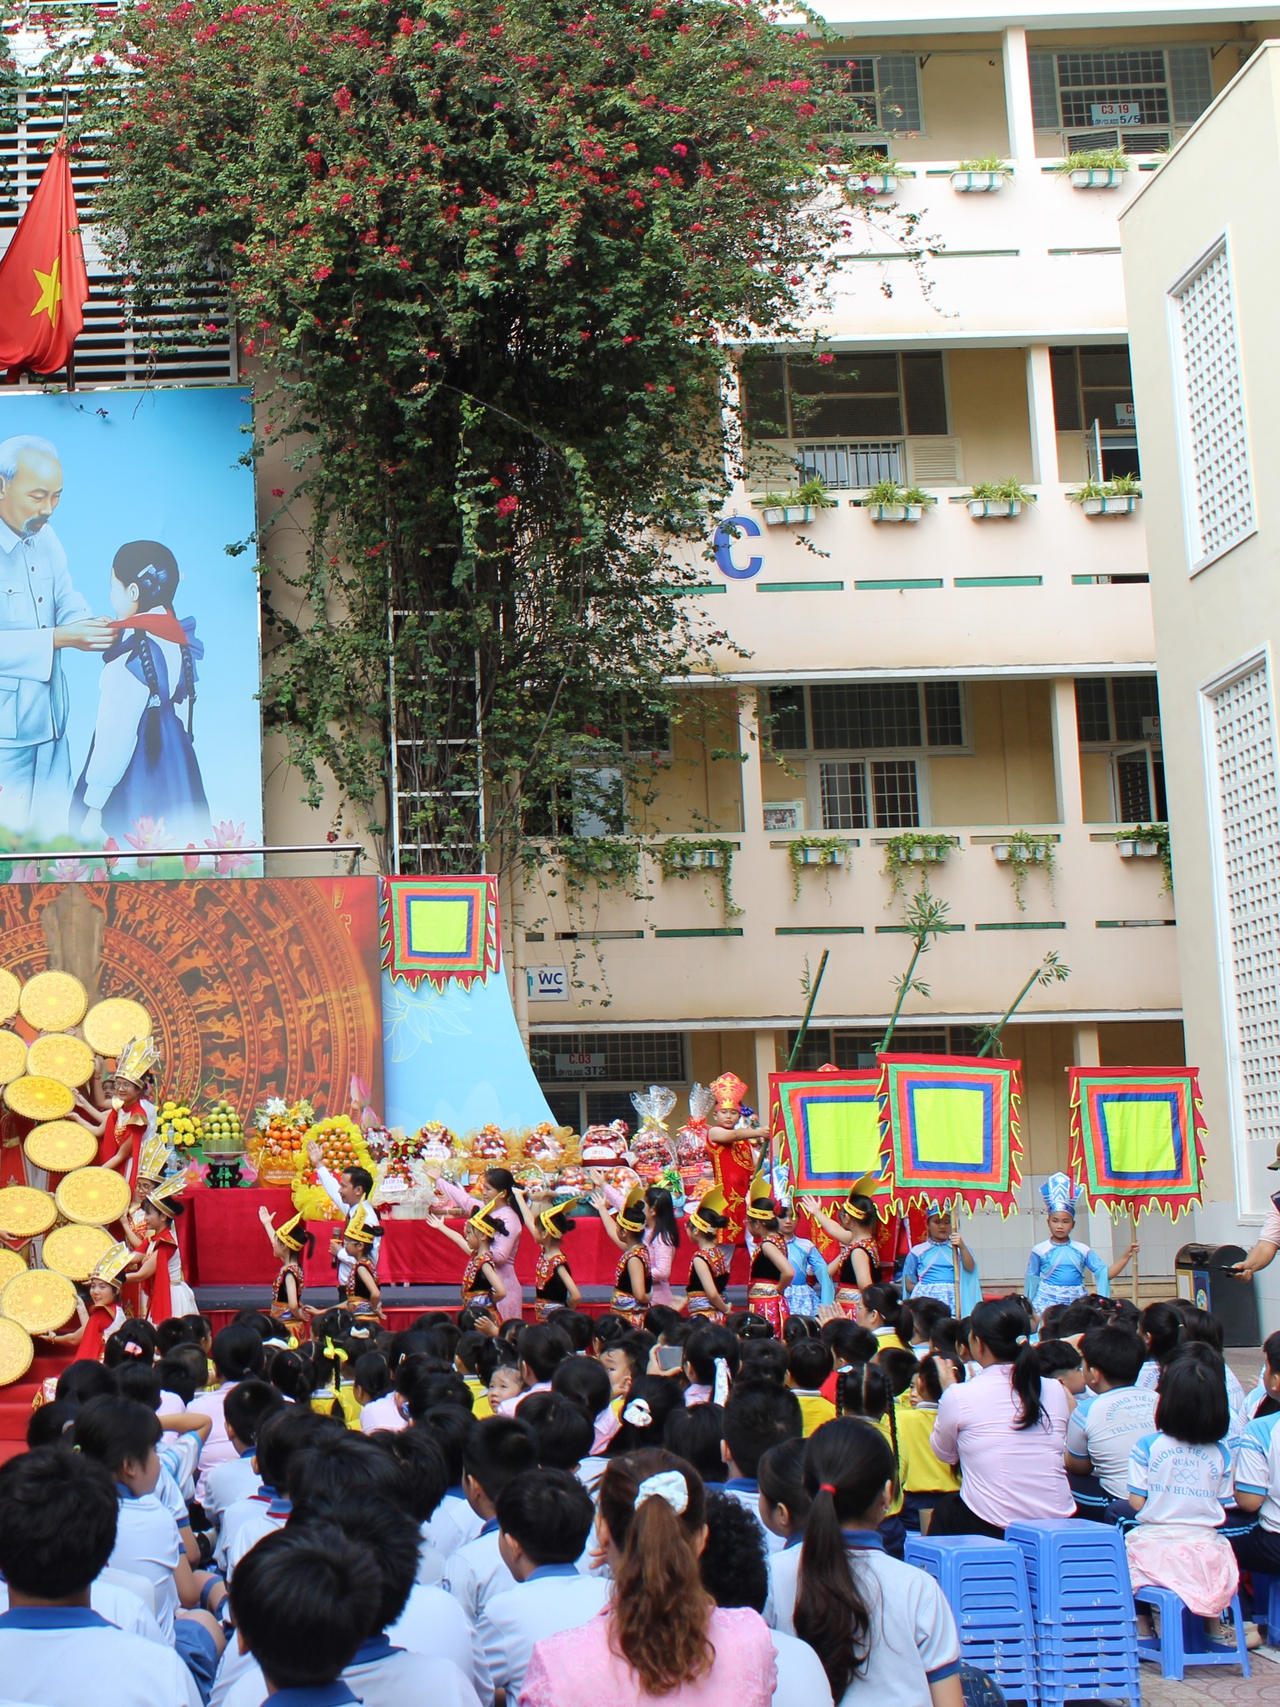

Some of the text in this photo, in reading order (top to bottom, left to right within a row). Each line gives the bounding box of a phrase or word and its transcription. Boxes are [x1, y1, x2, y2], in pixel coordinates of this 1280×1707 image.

[1101, 104, 1129, 114] C3.19
[1120, 115, 1141, 124] 5/5
[714, 516, 763, 579] C
[538, 972, 563, 985] WC
[569, 1053, 591, 1064] C.03
[584, 1065, 605, 1075] 3T2
